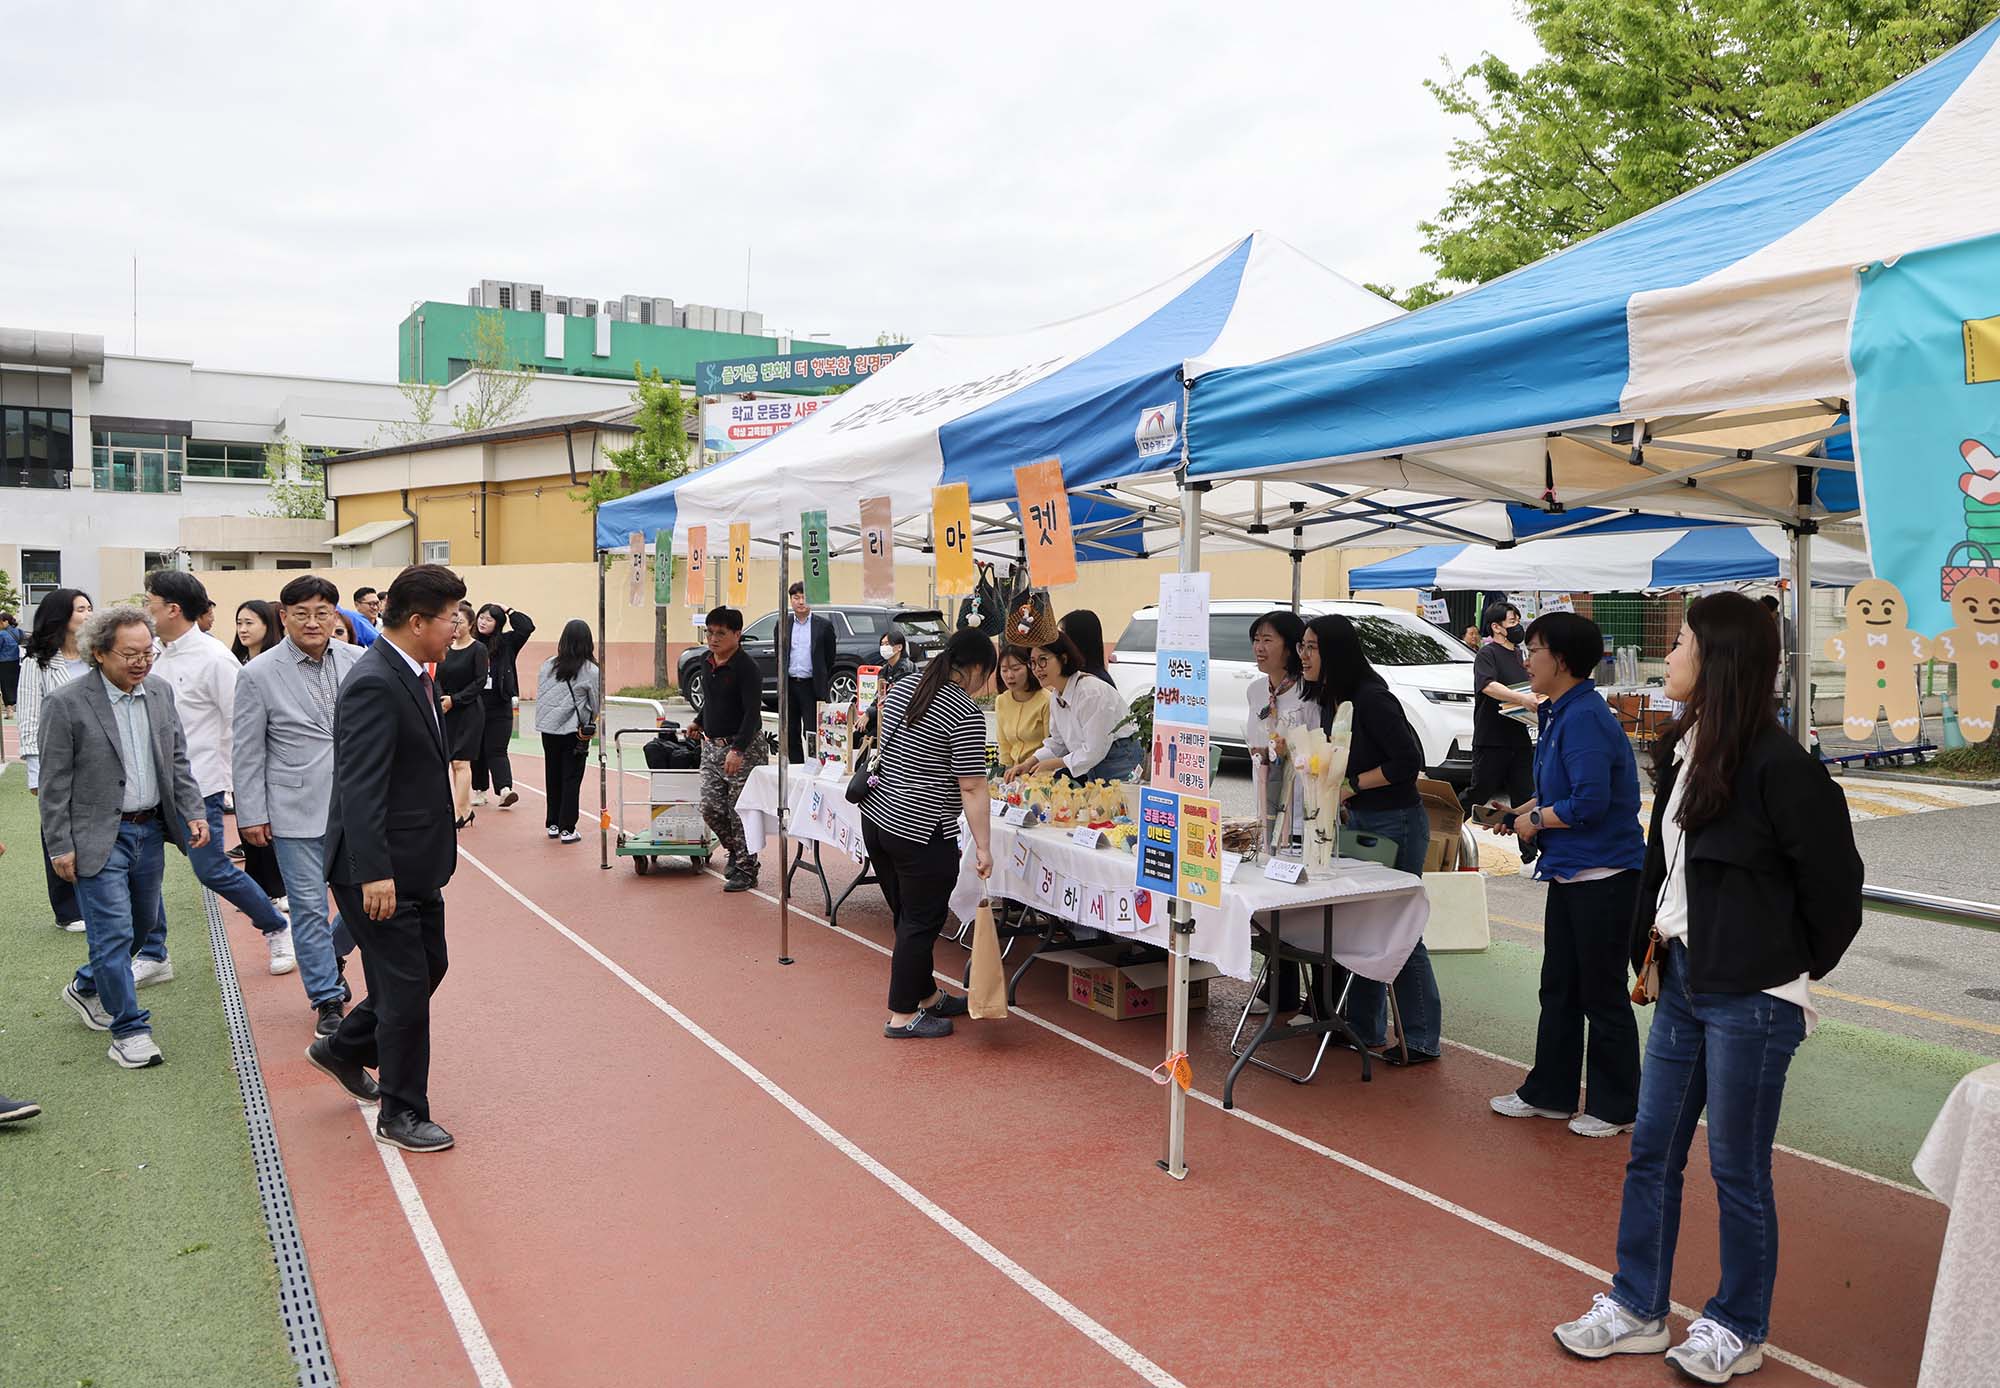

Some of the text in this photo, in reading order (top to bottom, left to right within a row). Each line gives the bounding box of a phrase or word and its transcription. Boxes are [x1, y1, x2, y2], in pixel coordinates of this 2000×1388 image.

[721, 352, 904, 385] 즐거운 변화! 더 행복한 원명교
[732, 401, 818, 422] 학교 운동장 사용
[1168, 657, 1192, 678] 생수는
[1179, 731, 1206, 751] 카페마루
[1178, 752, 1206, 769] 화장실만
[1178, 772, 1205, 789] 이용가능
[1144, 807, 1176, 828] 경품추첨
[1147, 825, 1172, 844] 이벤트
